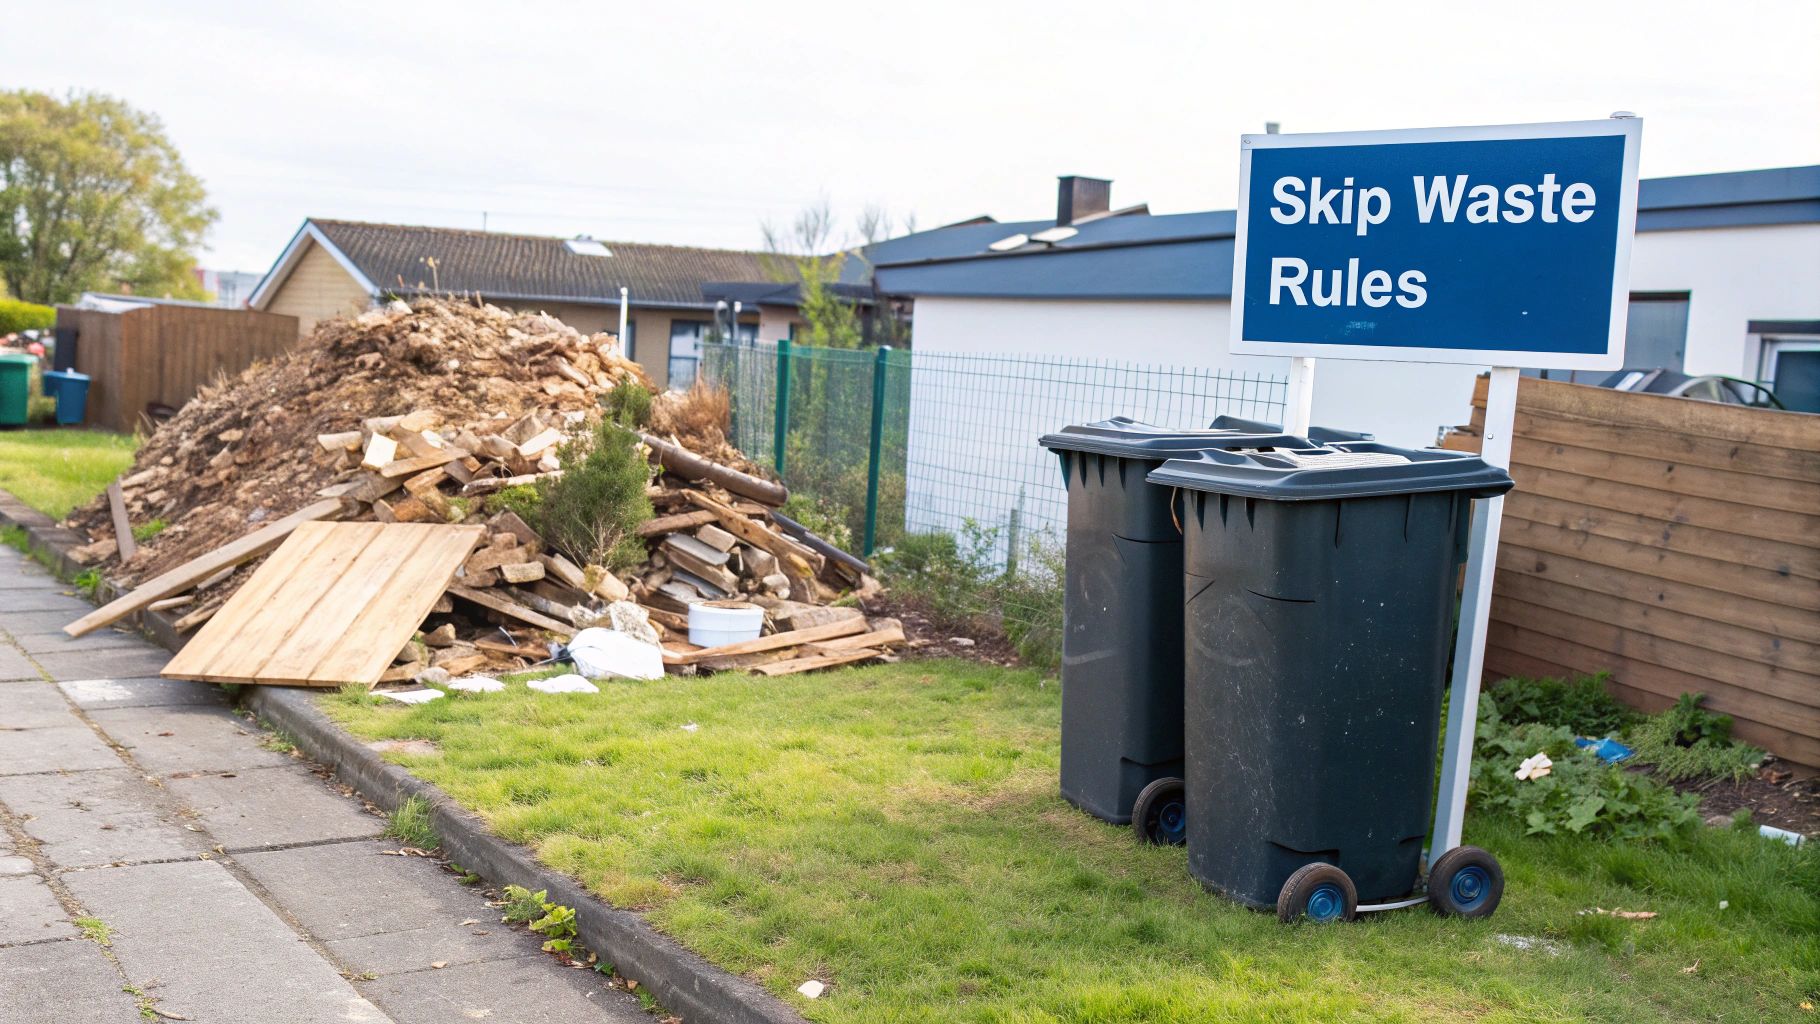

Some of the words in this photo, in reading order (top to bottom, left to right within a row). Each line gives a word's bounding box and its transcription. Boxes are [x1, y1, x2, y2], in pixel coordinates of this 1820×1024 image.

[1269, 176, 1391, 236] Skip
[1413, 173, 1597, 224] Waste
[1269, 257, 1428, 309] Rules
